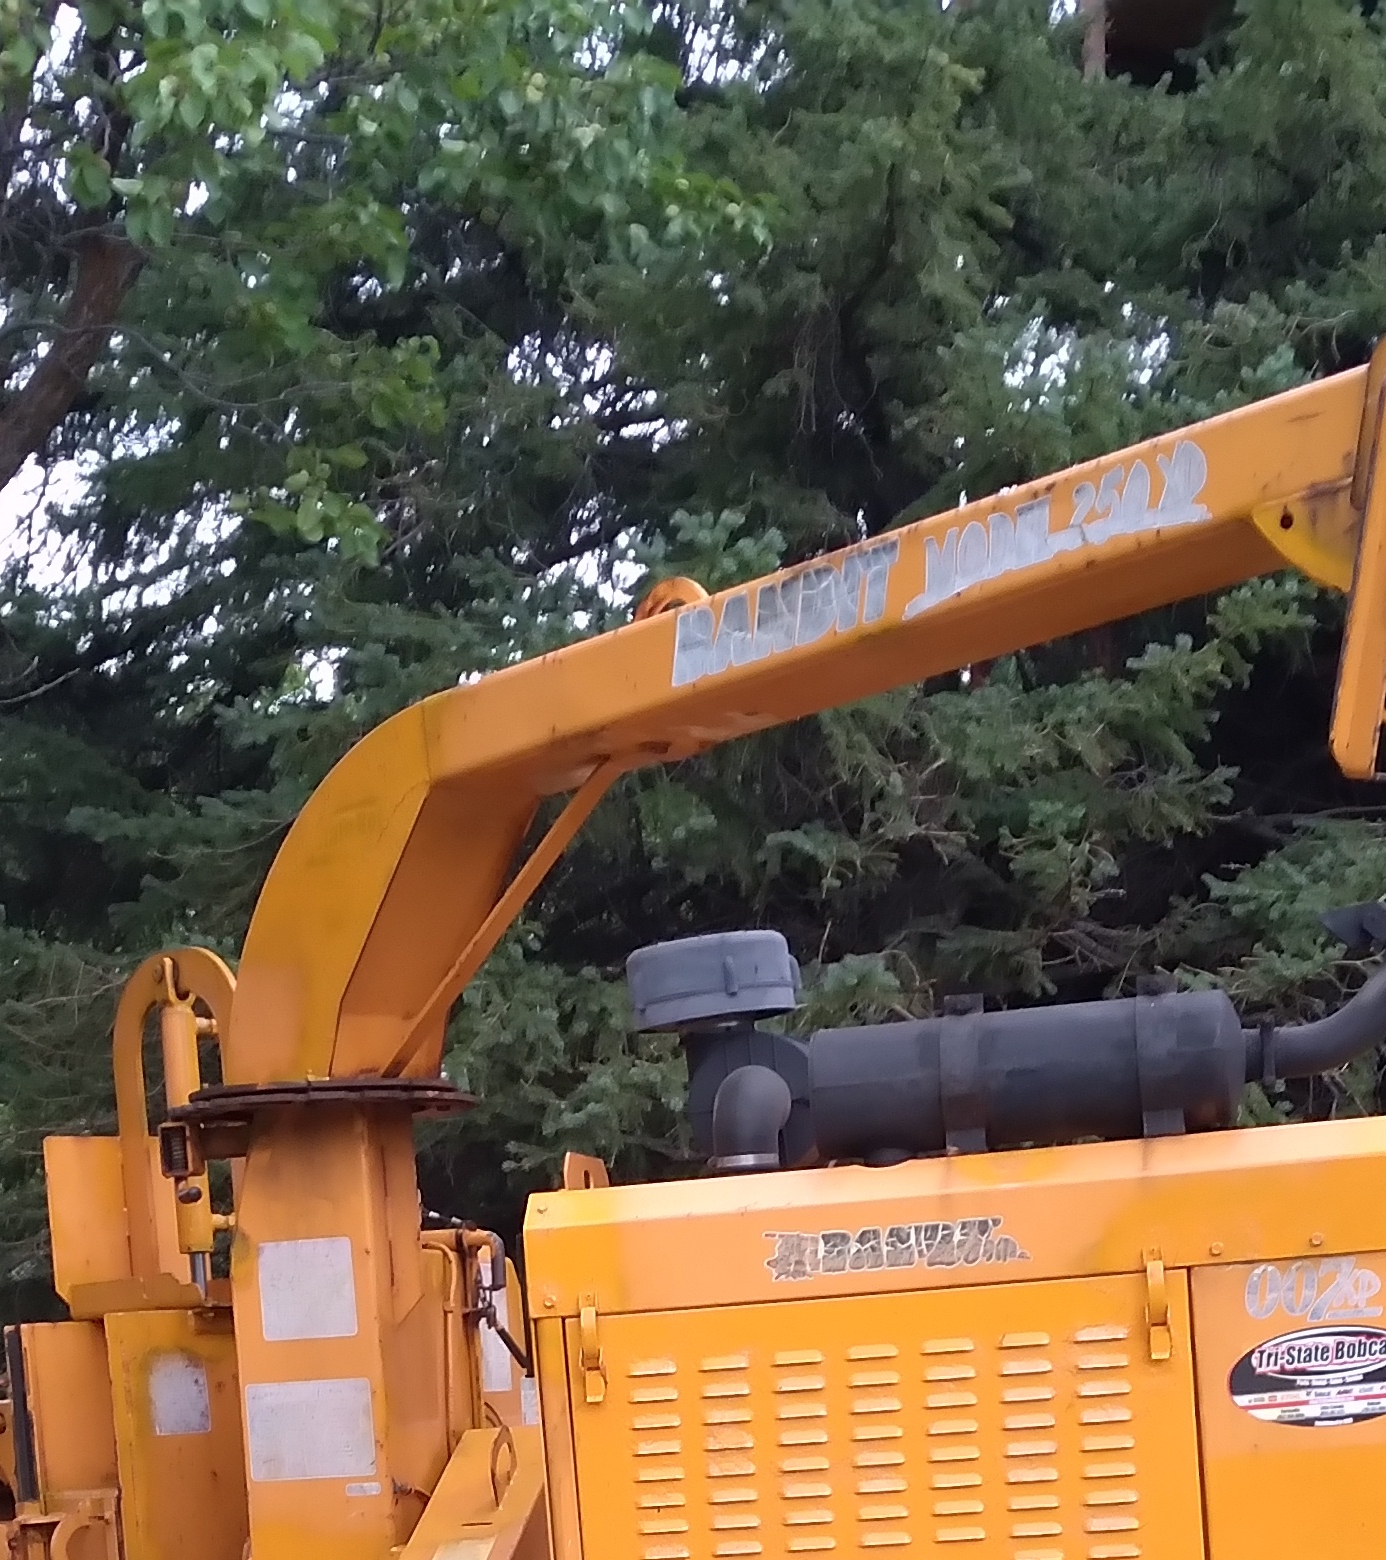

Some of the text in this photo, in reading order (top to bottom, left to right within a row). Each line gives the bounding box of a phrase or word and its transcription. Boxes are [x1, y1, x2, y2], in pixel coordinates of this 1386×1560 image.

[671, 536, 901, 689] BANDIT
[917, 495, 1053, 603] MODEL
[1255, 1345, 1331, 1371] Tri-State
